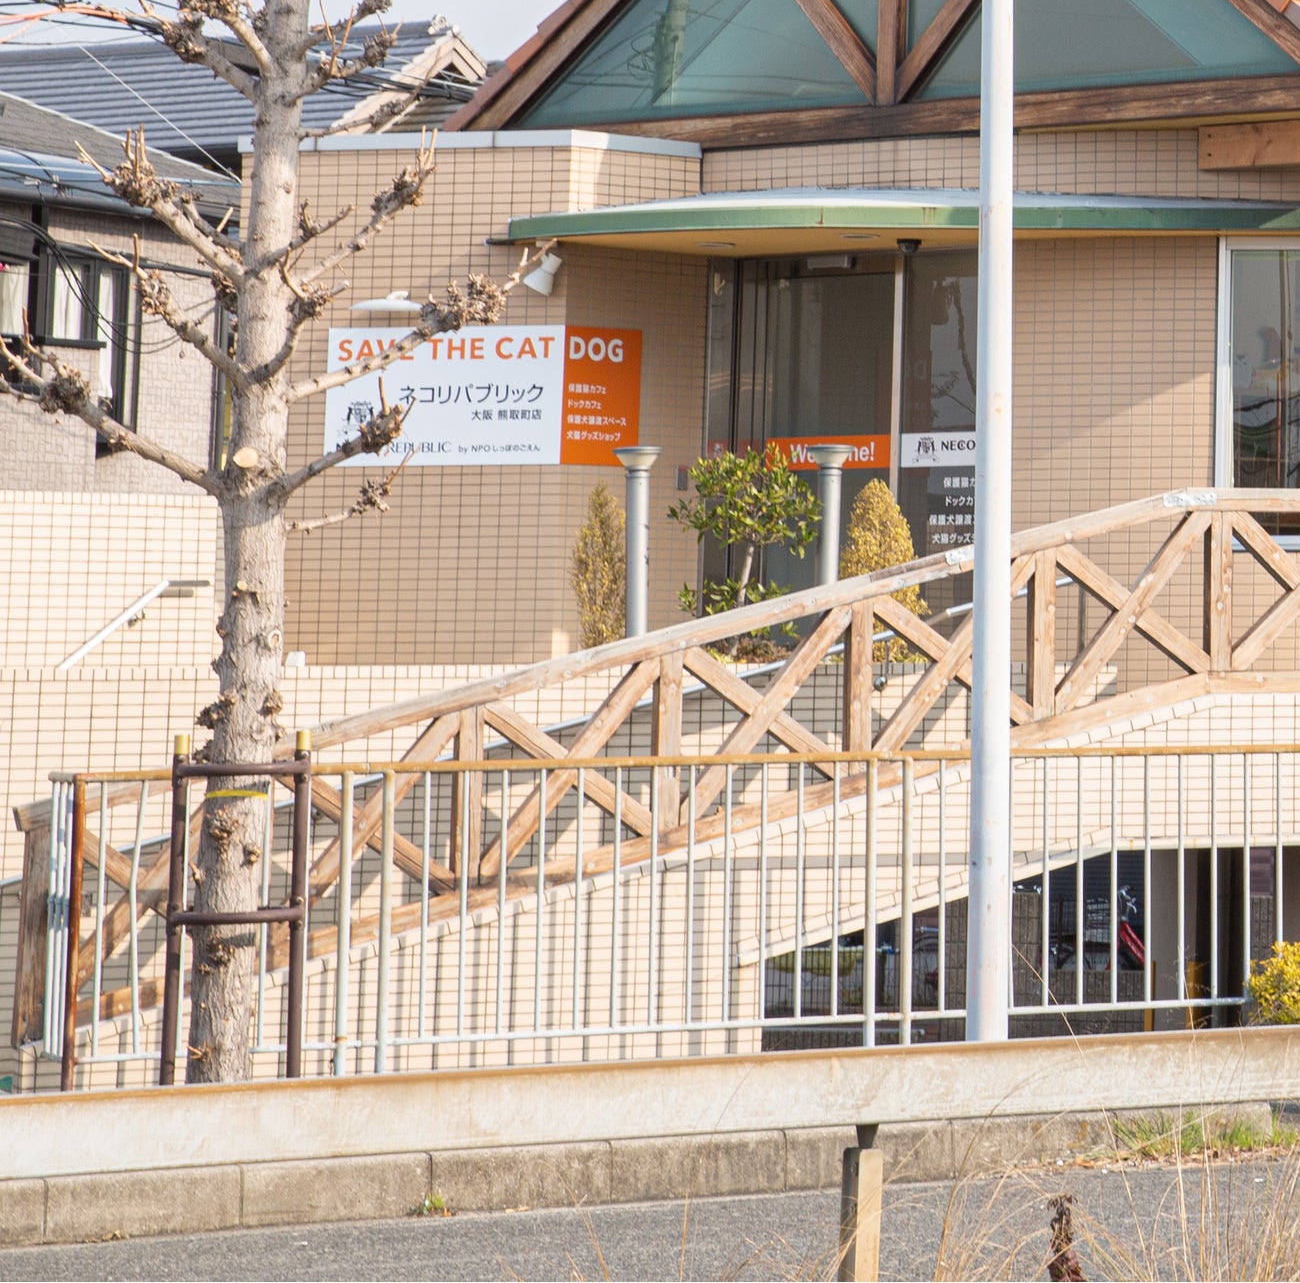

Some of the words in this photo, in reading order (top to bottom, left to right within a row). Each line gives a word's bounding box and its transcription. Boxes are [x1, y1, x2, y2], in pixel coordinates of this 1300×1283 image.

[427, 338, 485, 360] THE
[495, 337, 555, 360] CAT
[569, 336, 624, 363] DOG
[399, 383, 544, 404] ネコリパブリック
[471, 409, 493, 421] 大阪
[497, 409, 542, 421] 熊取町店
